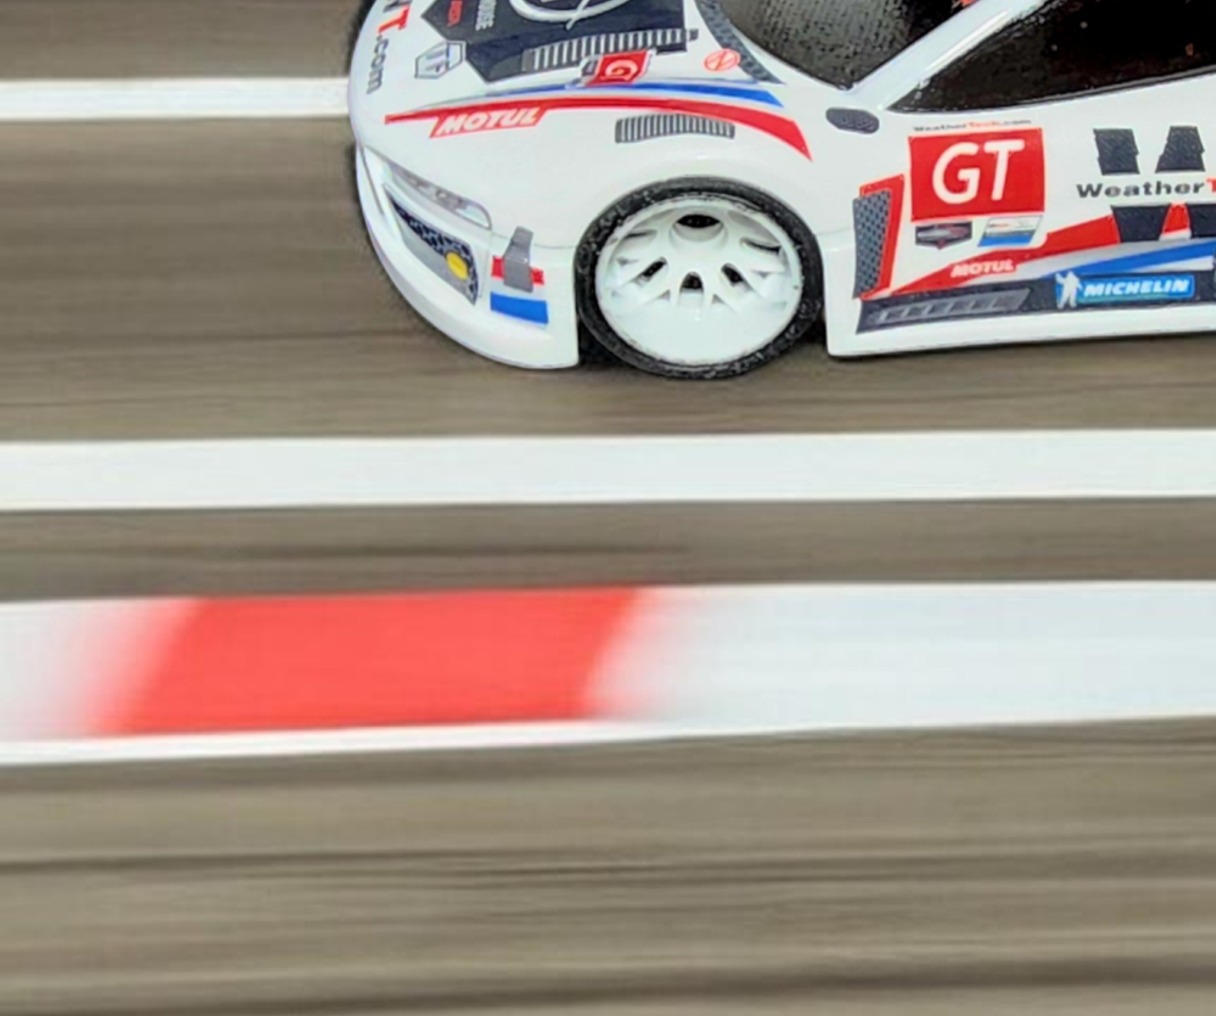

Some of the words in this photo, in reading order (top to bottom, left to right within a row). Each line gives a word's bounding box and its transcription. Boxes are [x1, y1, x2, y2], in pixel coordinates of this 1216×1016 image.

[439, 107, 540, 135] MOTUL
[932, 138, 1026, 205] GT
[950, 259, 1015, 279] MOTUL
[1083, 279, 1190, 298] MICHELIN
